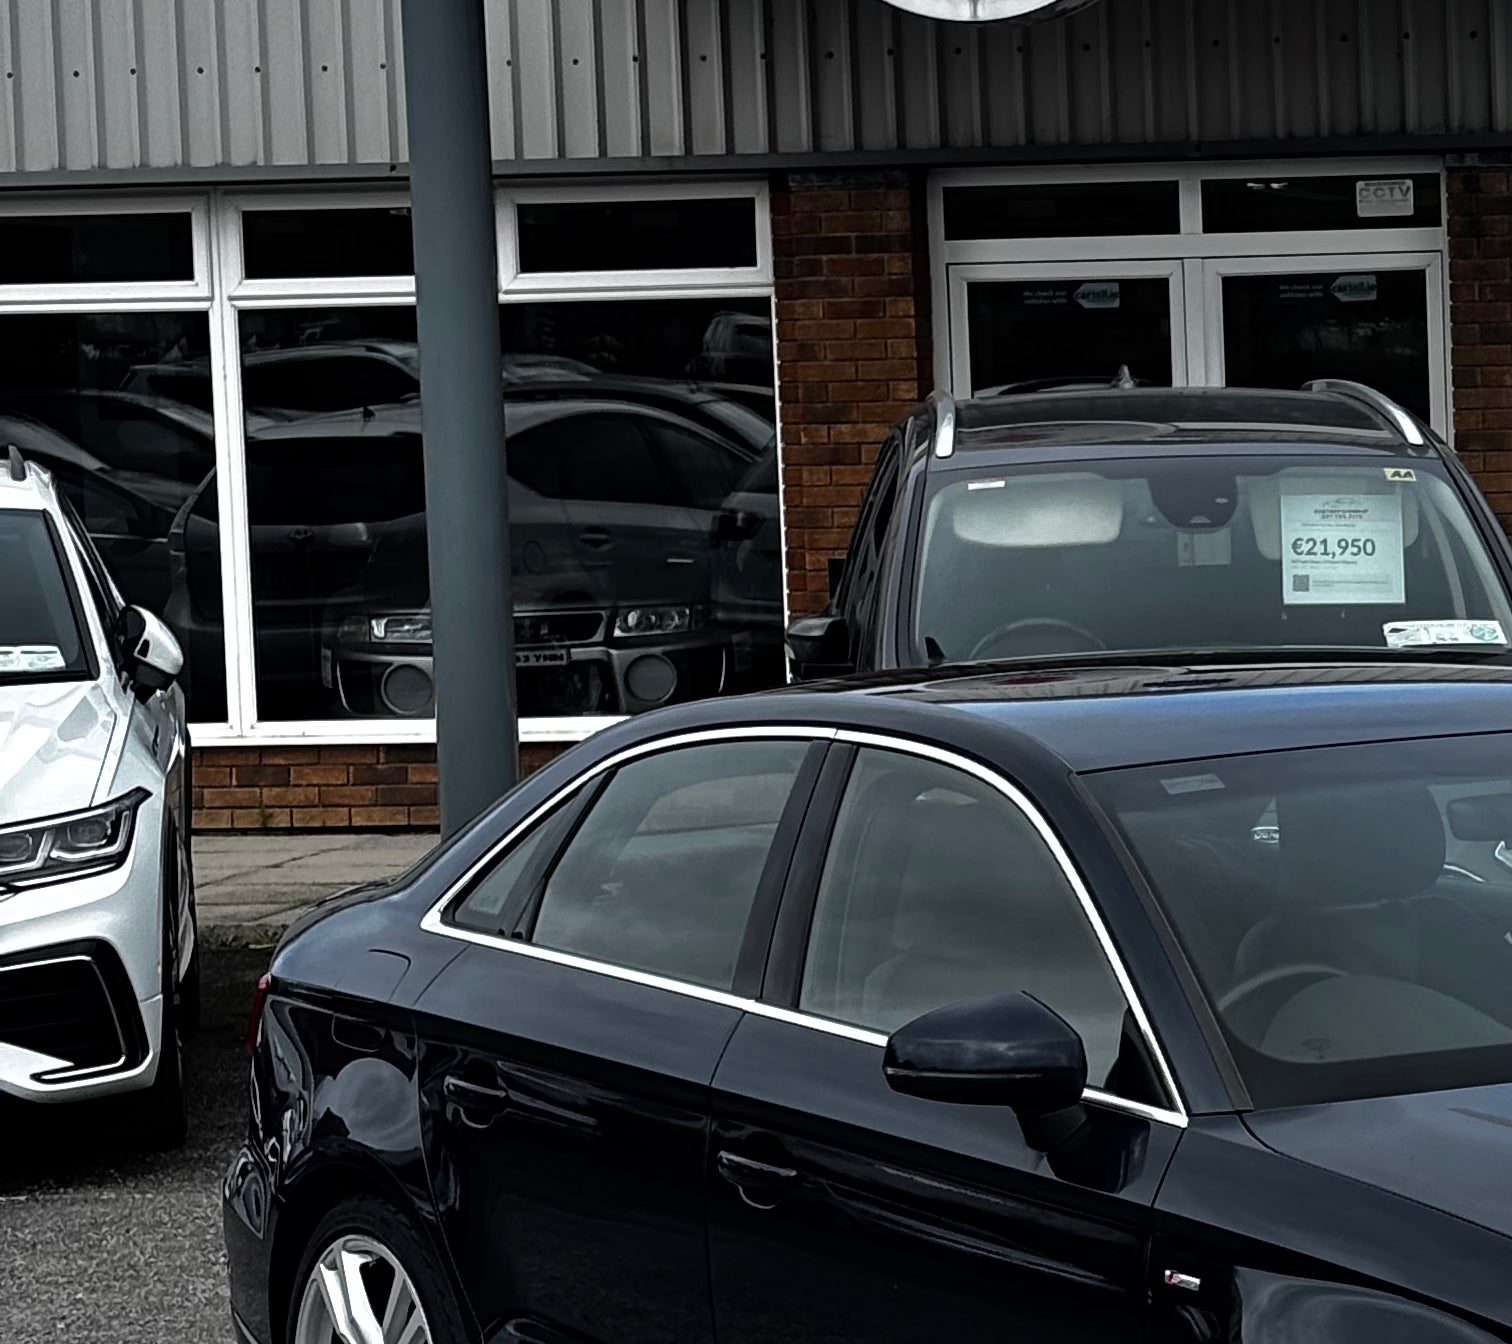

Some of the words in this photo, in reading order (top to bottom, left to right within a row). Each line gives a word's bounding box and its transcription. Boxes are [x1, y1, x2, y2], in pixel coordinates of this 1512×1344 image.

[1359, 186, 1410, 199] CCTV
[1390, 470, 1414, 479] AA
[1291, 537, 1376, 559] €21,950
